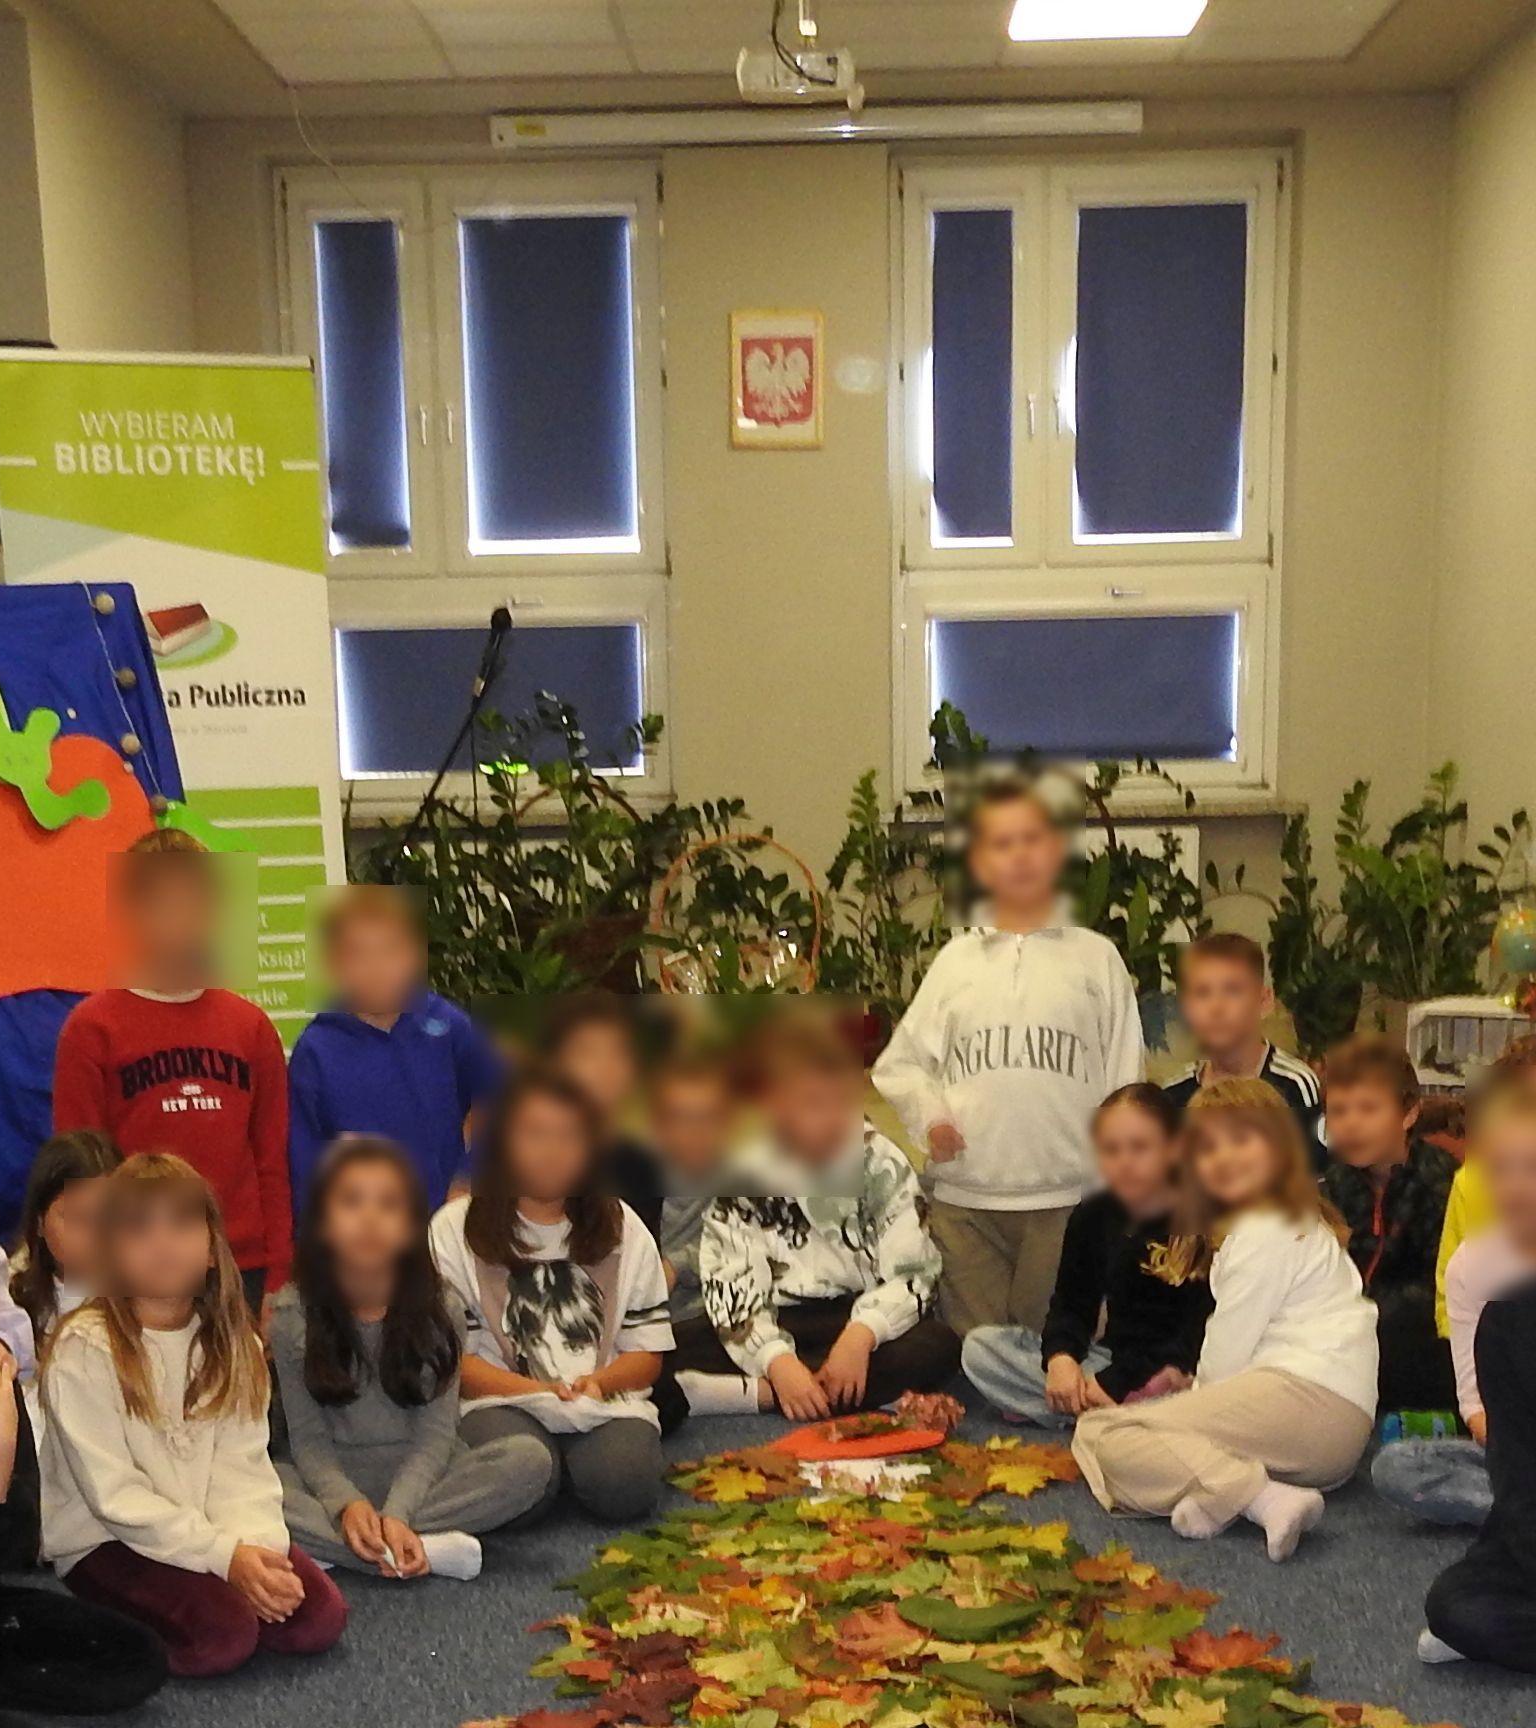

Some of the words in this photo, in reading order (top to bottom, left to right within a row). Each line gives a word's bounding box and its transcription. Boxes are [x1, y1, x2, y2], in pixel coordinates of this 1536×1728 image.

[79, 410, 236, 441] WYBIERAM
[54, 442, 266, 486] BIBLIOTEKĘ!
[189, 681, 306, 708] Publiczna
[120, 1047, 251, 1099] BROOKLYN
[161, 1097, 188, 1112] NEW
[192, 1095, 222, 1110] YORK
